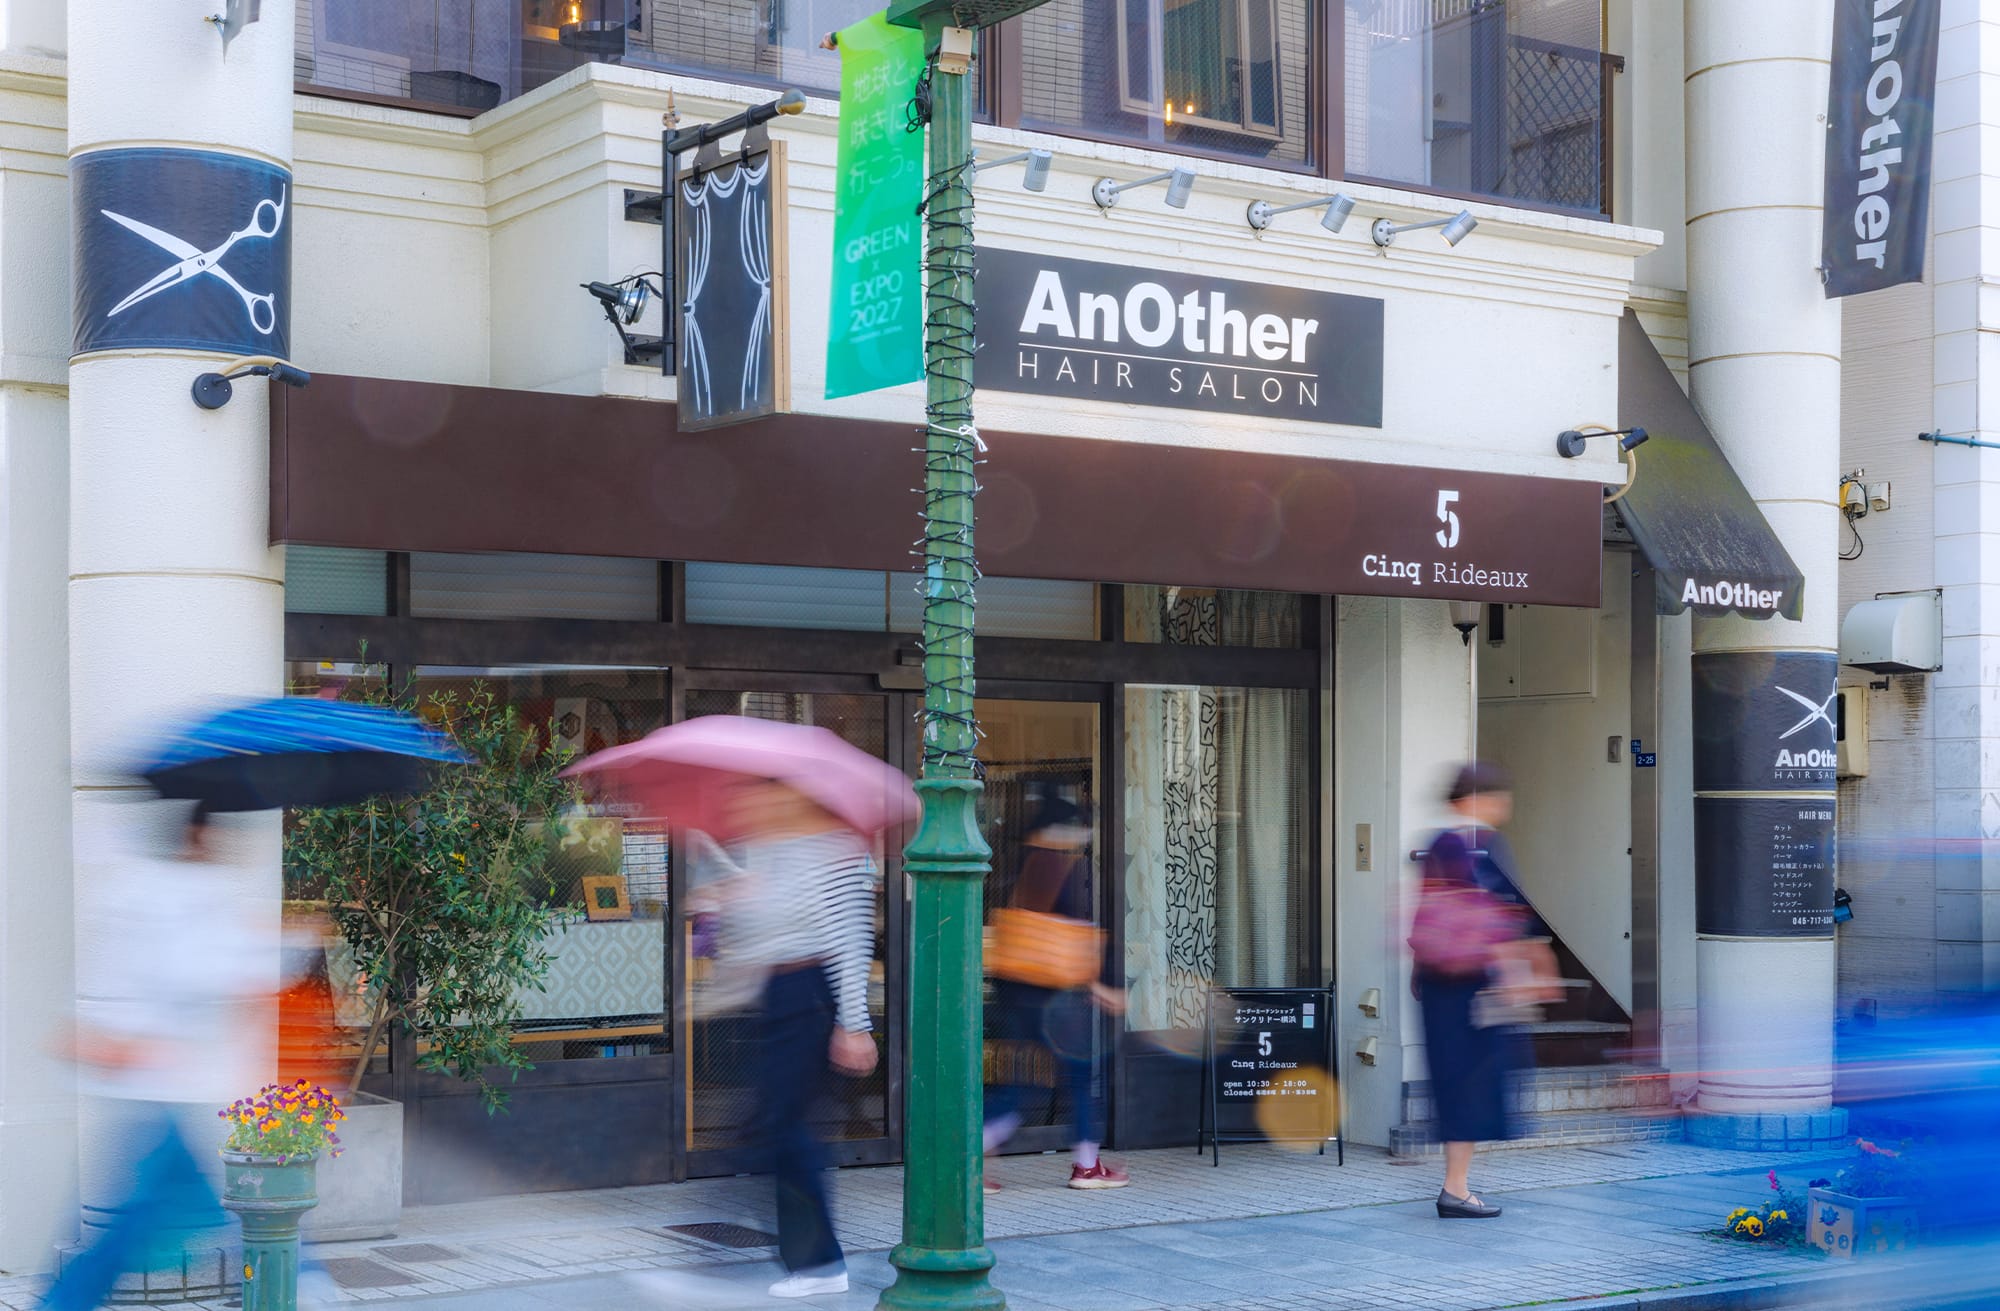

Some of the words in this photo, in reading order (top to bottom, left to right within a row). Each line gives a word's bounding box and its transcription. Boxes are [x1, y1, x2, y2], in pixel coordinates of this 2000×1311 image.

[853, 59, 917, 102] 地球と。
[851, 102, 909, 149] 咲きに
[849, 147, 915, 196] 行こう。
[845, 221, 910, 263] GREEN
[851, 269, 903, 306] EXPO
[850, 296, 903, 332] 2027
[1019, 269, 1319, 363] AnOther
[1019, 351, 1133, 389] HAIR
[1169, 367, 1318, 407] SALON
[1436, 489, 1460, 548] 5
[1362, 554, 1422, 585] Cinq
[1433, 561, 1529, 588] Rideaux
[1681, 577, 1783, 609] AnOther
[1637, 755, 1654, 765] 2-25
[1774, 770, 1811, 780] HAIR
[1798, 810, 1817, 820] HAIR
[1818, 810, 1832, 820] MENU
[1234, 1016, 1297, 1024] サンクリドー横浜
[1258, 1032, 1272, 1056] 5
[1231, 1060, 1255, 1070] Cinq
[1258, 1061, 1298, 1069] Rideaux
[1223, 1081, 1243, 1089] open
[1246, 1080, 1270, 1088] 10:30
[1223, 1089, 1254, 1097] closed
